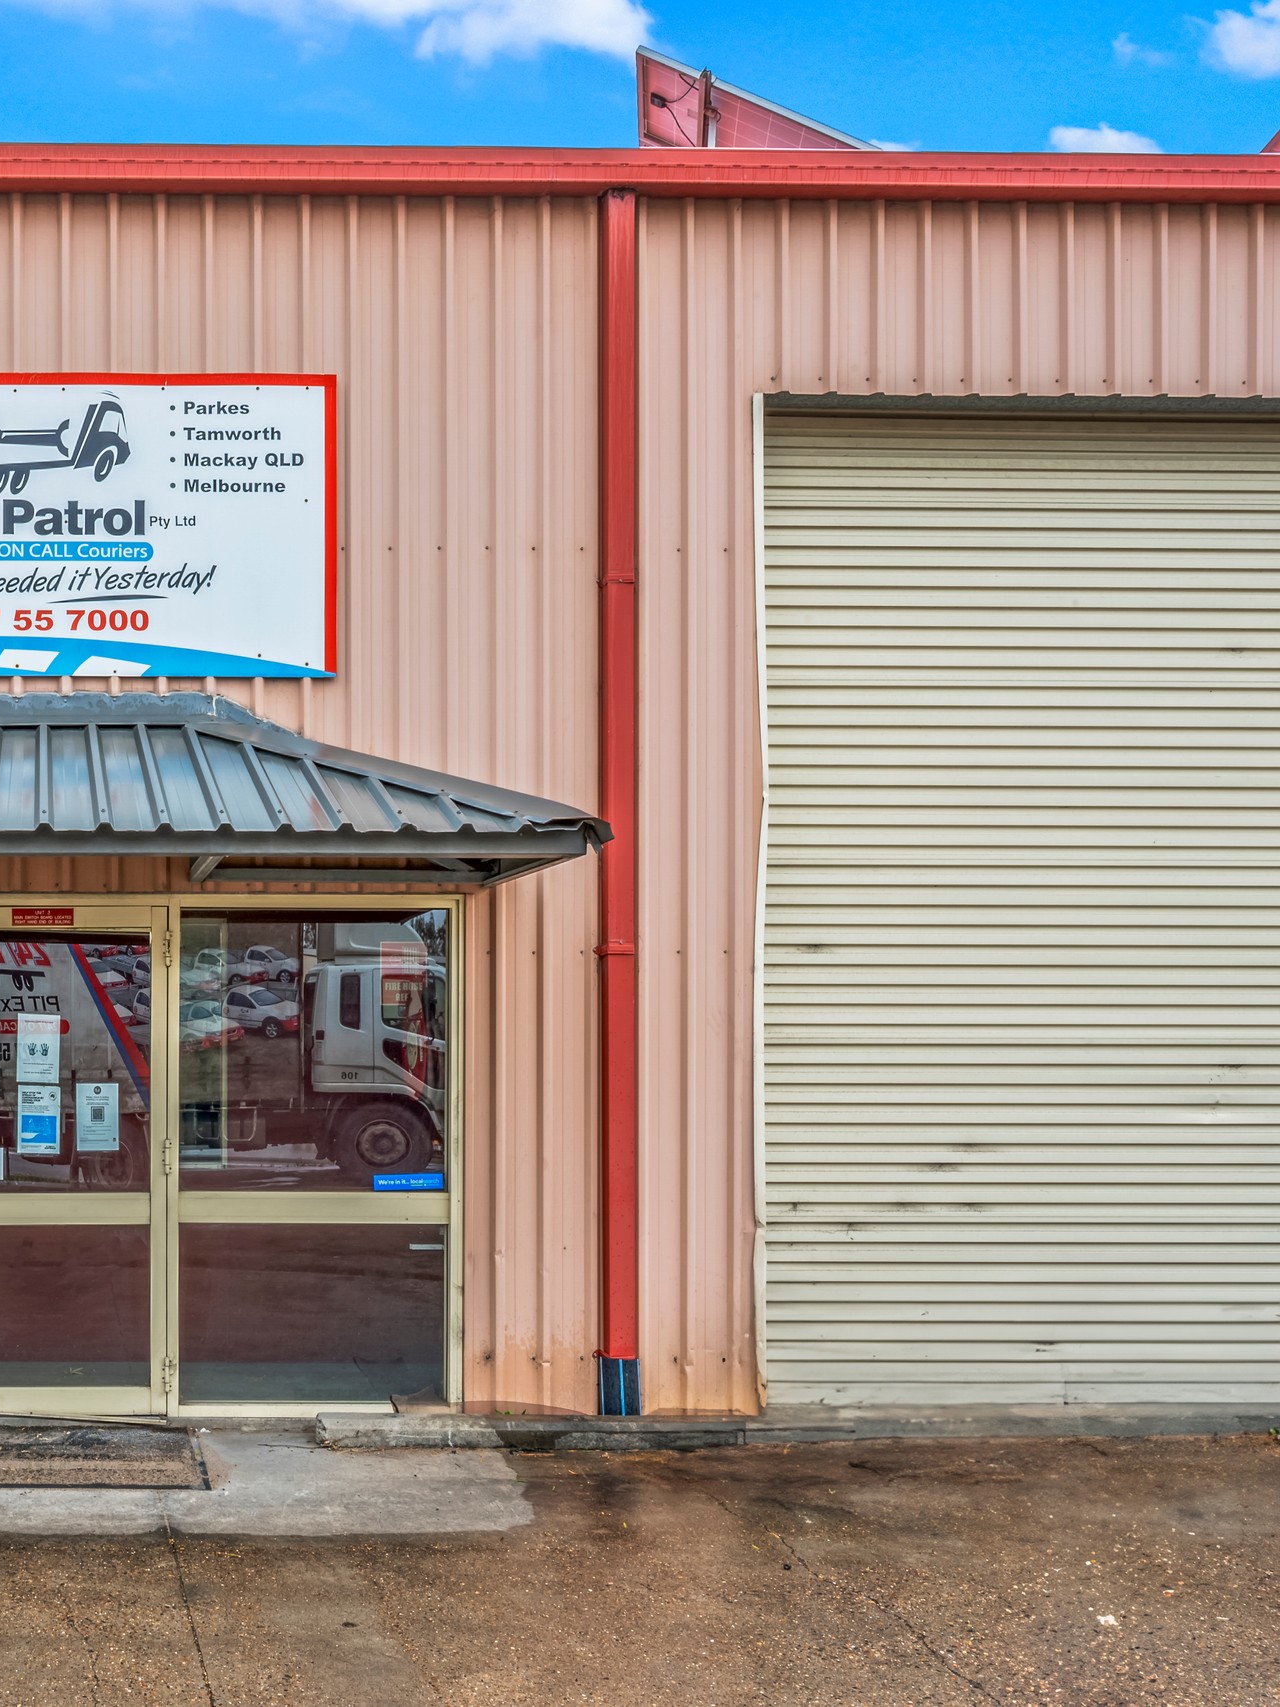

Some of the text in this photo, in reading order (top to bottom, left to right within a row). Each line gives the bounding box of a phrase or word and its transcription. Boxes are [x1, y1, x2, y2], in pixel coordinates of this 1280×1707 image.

[183, 401, 250, 415] Parkes
[183, 427, 282, 441] Tamworth
[183, 453, 305, 470] Mackay QLD
[183, 479, 286, 493] Melbourne
[2, 498, 146, 536] Patrol
[149, 515, 171, 530] Pty
[174, 515, 197, 527] Ltd
[28, 543, 73, 558] CALL
[76, 543, 149, 559] Couriers
[68, 566, 92, 592] it
[92, 563, 218, 596] Yesterday!
[13, 609, 55, 632] 55
[66, 609, 150, 632] 7000
[384, 982, 423, 992] FIRE HOSE
